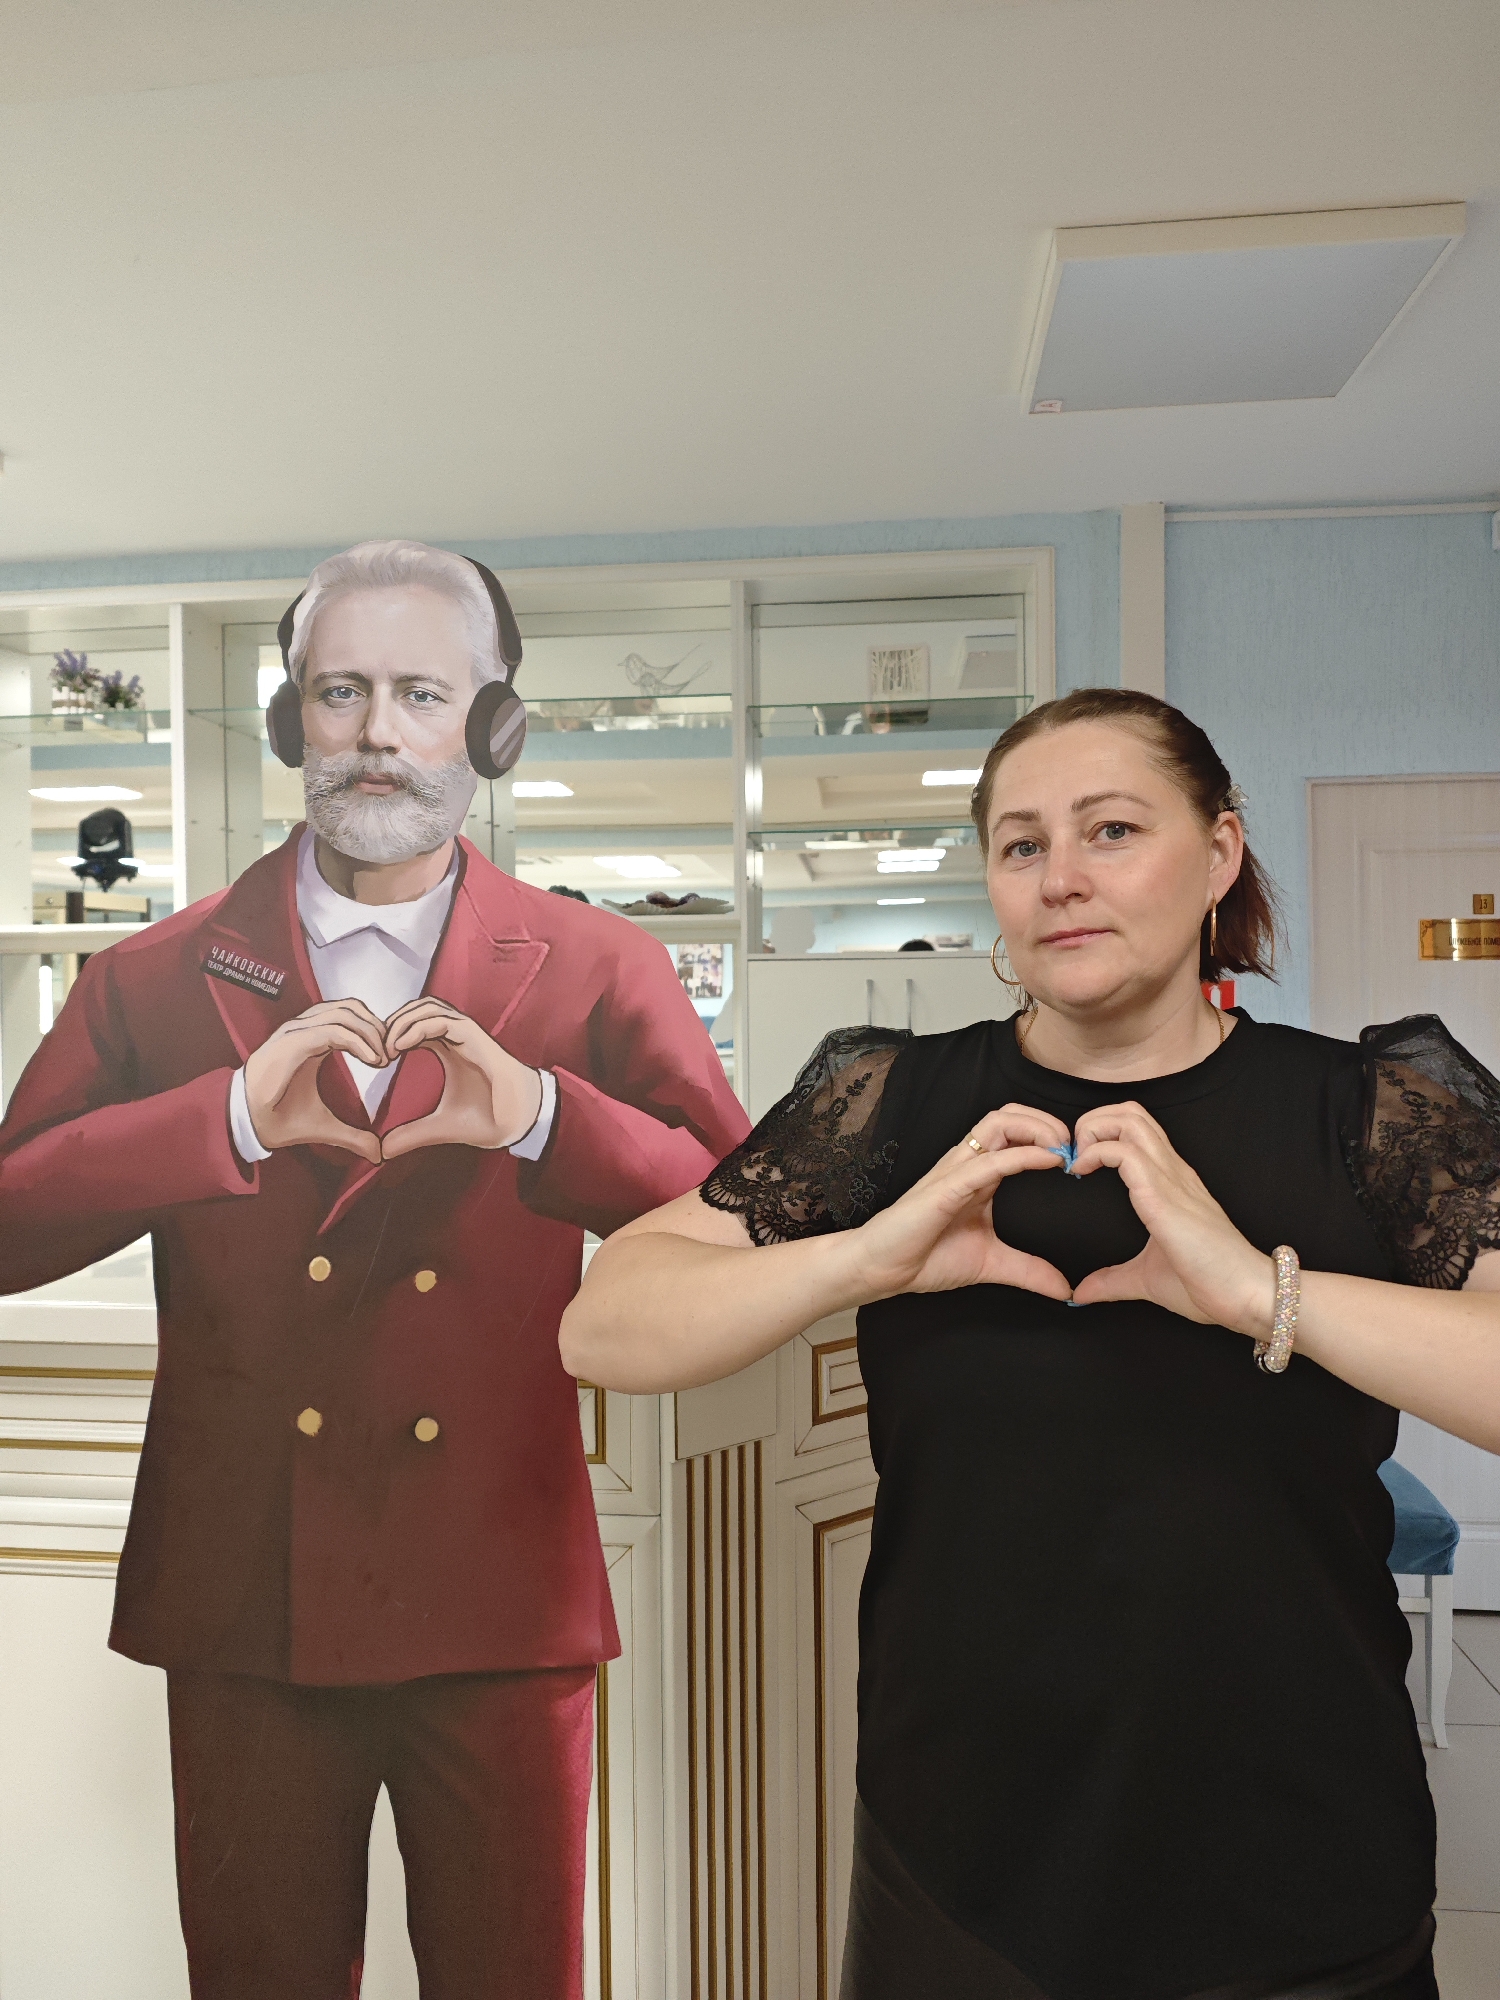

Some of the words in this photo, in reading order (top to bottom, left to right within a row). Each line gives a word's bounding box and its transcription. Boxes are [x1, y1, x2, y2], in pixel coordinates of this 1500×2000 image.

[1479, 898, 1488, 910] 13
[207, 959, 224, 971] ТЕАТР
[223, 967, 246, 981] ДРАМЫ
[250, 978, 279, 996] КОМЕДИИ
[211, 945, 286, 986] ЧАЙКОВСКИЙ
